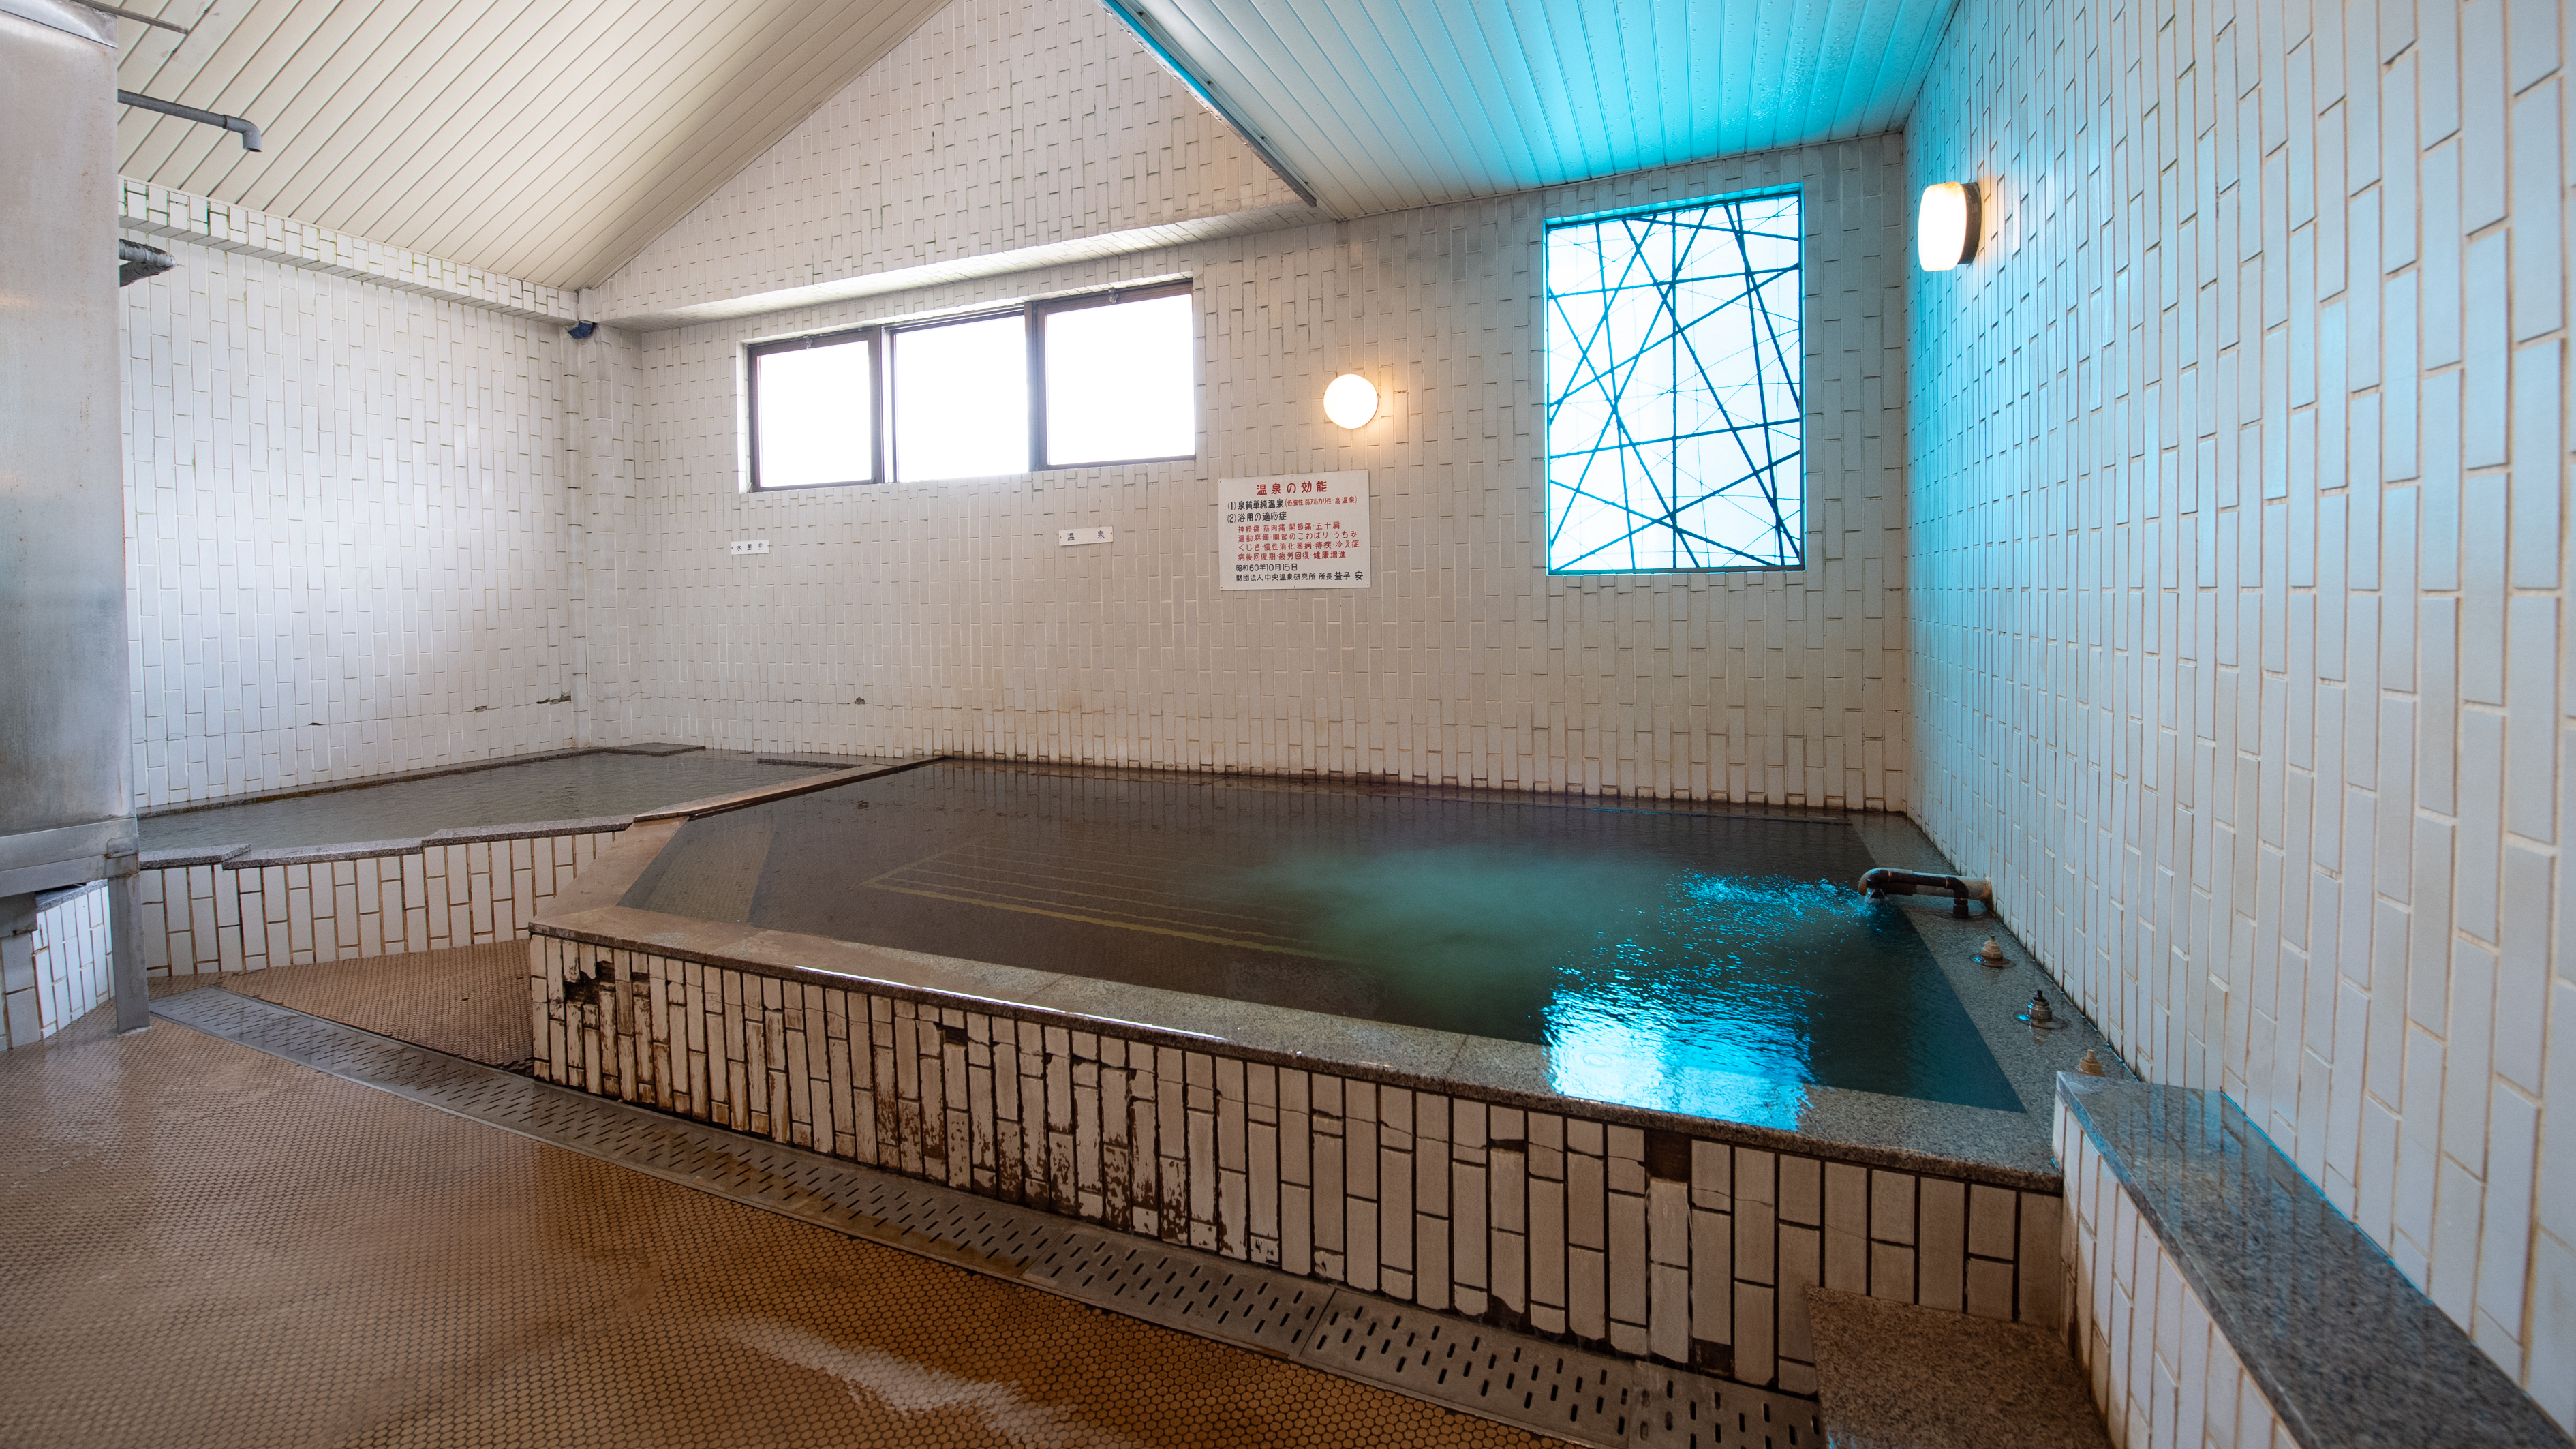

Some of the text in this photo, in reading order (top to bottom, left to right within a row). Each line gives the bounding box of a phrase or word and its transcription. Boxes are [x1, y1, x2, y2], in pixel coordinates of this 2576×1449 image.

[1256, 481, 1328, 495] 温泉の効能
[1067, 530, 1105, 541] 温泉
[1236, 563, 1298, 572] 昭和60年10月15日
